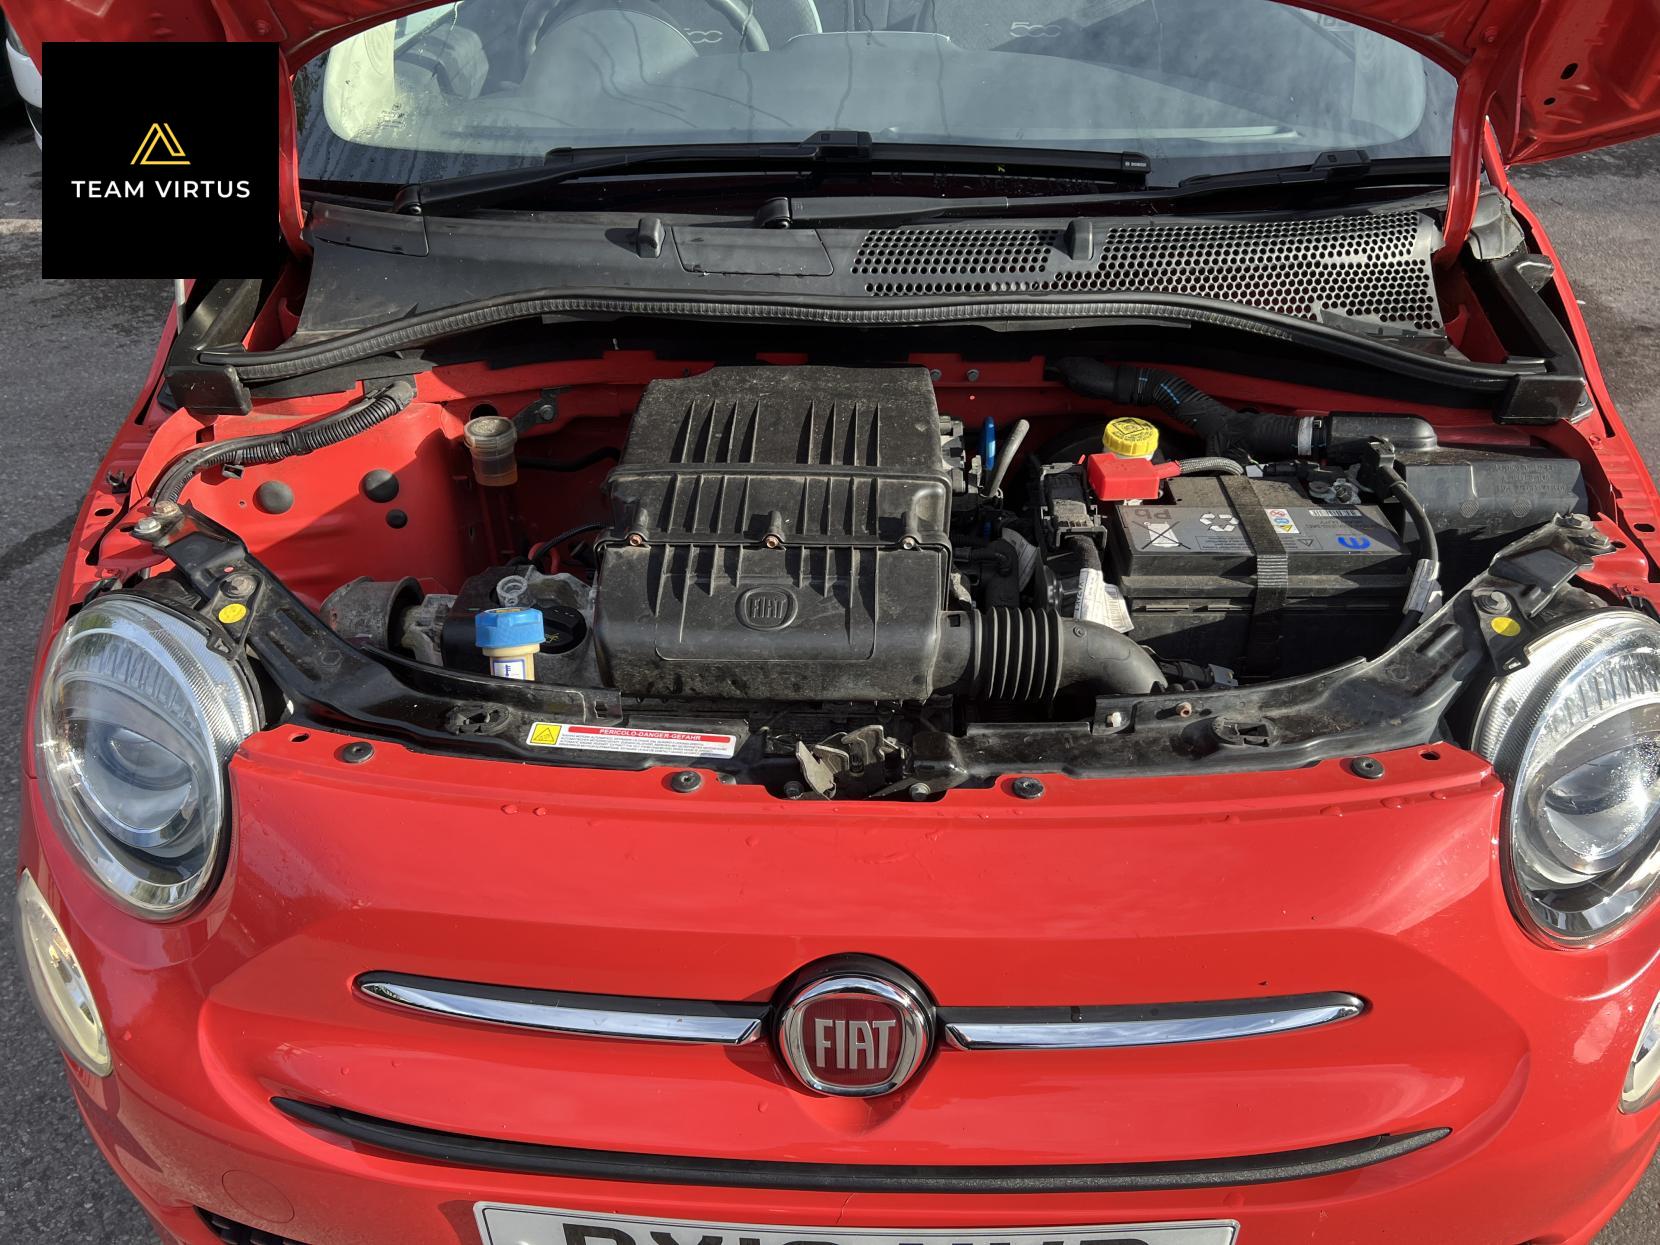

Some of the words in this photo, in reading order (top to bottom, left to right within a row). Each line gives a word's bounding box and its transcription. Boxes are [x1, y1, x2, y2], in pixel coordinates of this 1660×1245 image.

[684, 27, 723, 44] 00
[751, 596, 787, 618] FIAT
[815, 1018, 896, 1070] FIAT
